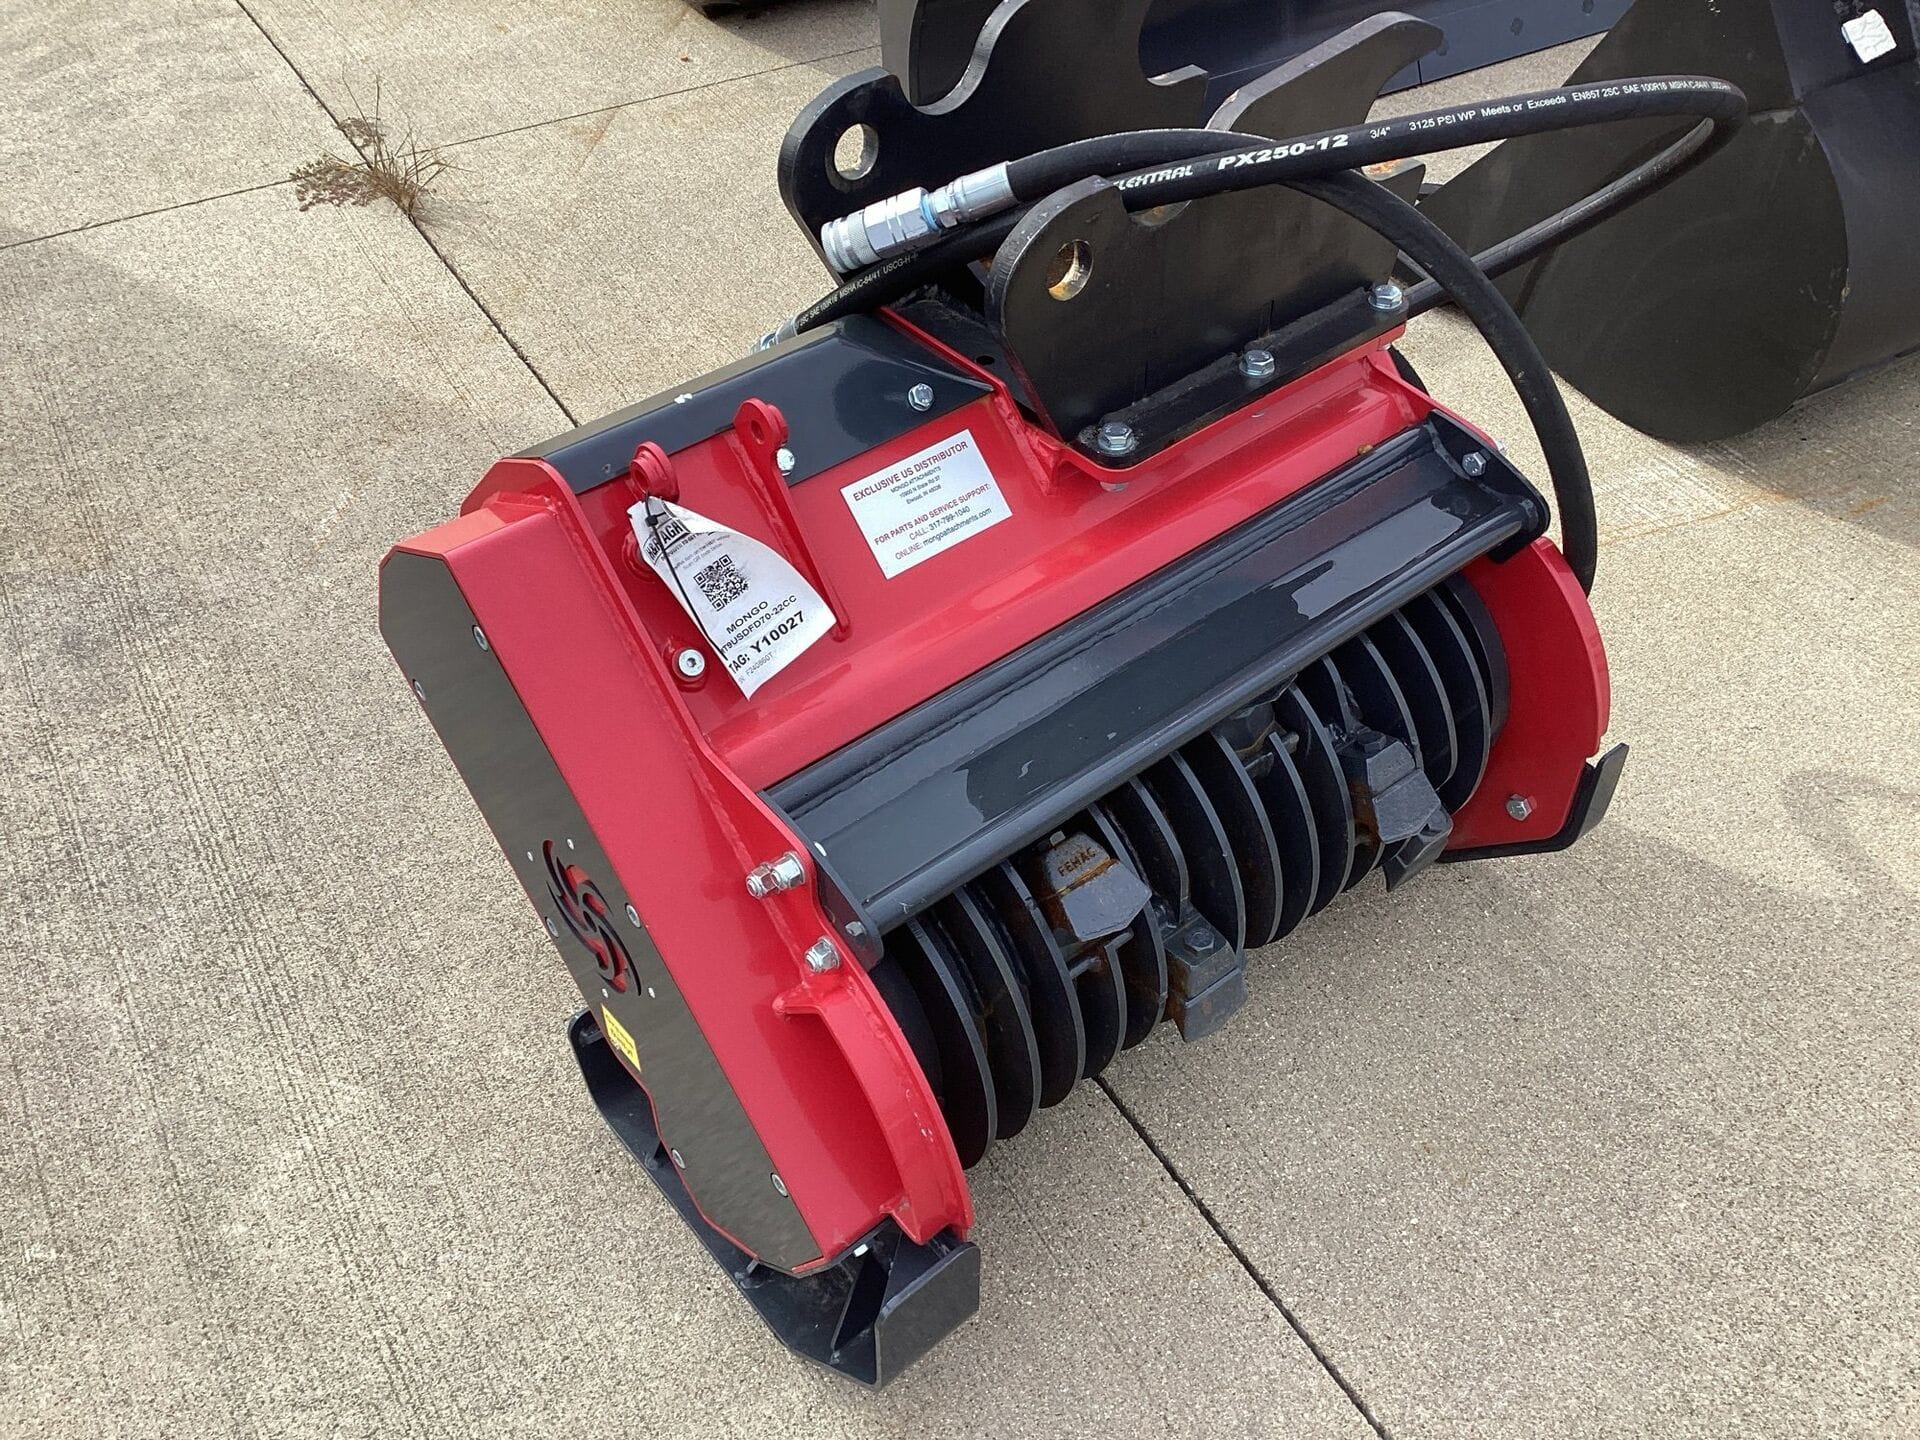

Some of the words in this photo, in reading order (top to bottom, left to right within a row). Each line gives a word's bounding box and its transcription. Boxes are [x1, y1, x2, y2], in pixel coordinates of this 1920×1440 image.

[1218, 135, 1349, 170] PX250-12
[1370, 126, 1391, 140] 3/4"
[1408, 118, 1435, 131] 3125
[1437, 114, 1456, 127] PSI
[1456, 109, 1476, 122] WP
[1481, 104, 1511, 118] Meets
[1513, 103, 1523, 113] or
[1527, 95, 1566, 110] Exceeds
[1572, 89, 1601, 102] EN857
[1602, 87, 1620, 97] 2SC
[1623, 84, 1639, 94] SAE
[809, 307, 820, 318] SAE
[853, 475, 900, 501] EXCLUSIVE
[901, 467, 912, 478] US
[914, 441, 967, 471] DISTRIBUTOR
[875, 533, 890, 545] FOR
[890, 522, 913, 537] PARTS
[913, 514, 928, 526] AND
[929, 499, 958, 517] SERVICE
[958, 483, 990, 502] SUPPORT:
[894, 541, 923, 560] ONLINE:
[921, 507, 993, 548] mongoattachments.com
[909, 526, 929, 541] CALL:
[928, 505, 970, 530] 317-799-1040
[727, 601, 768, 634] MONGO
[728, 655, 750, 674] TAG:
[750, 610, 804, 653] Y10027
